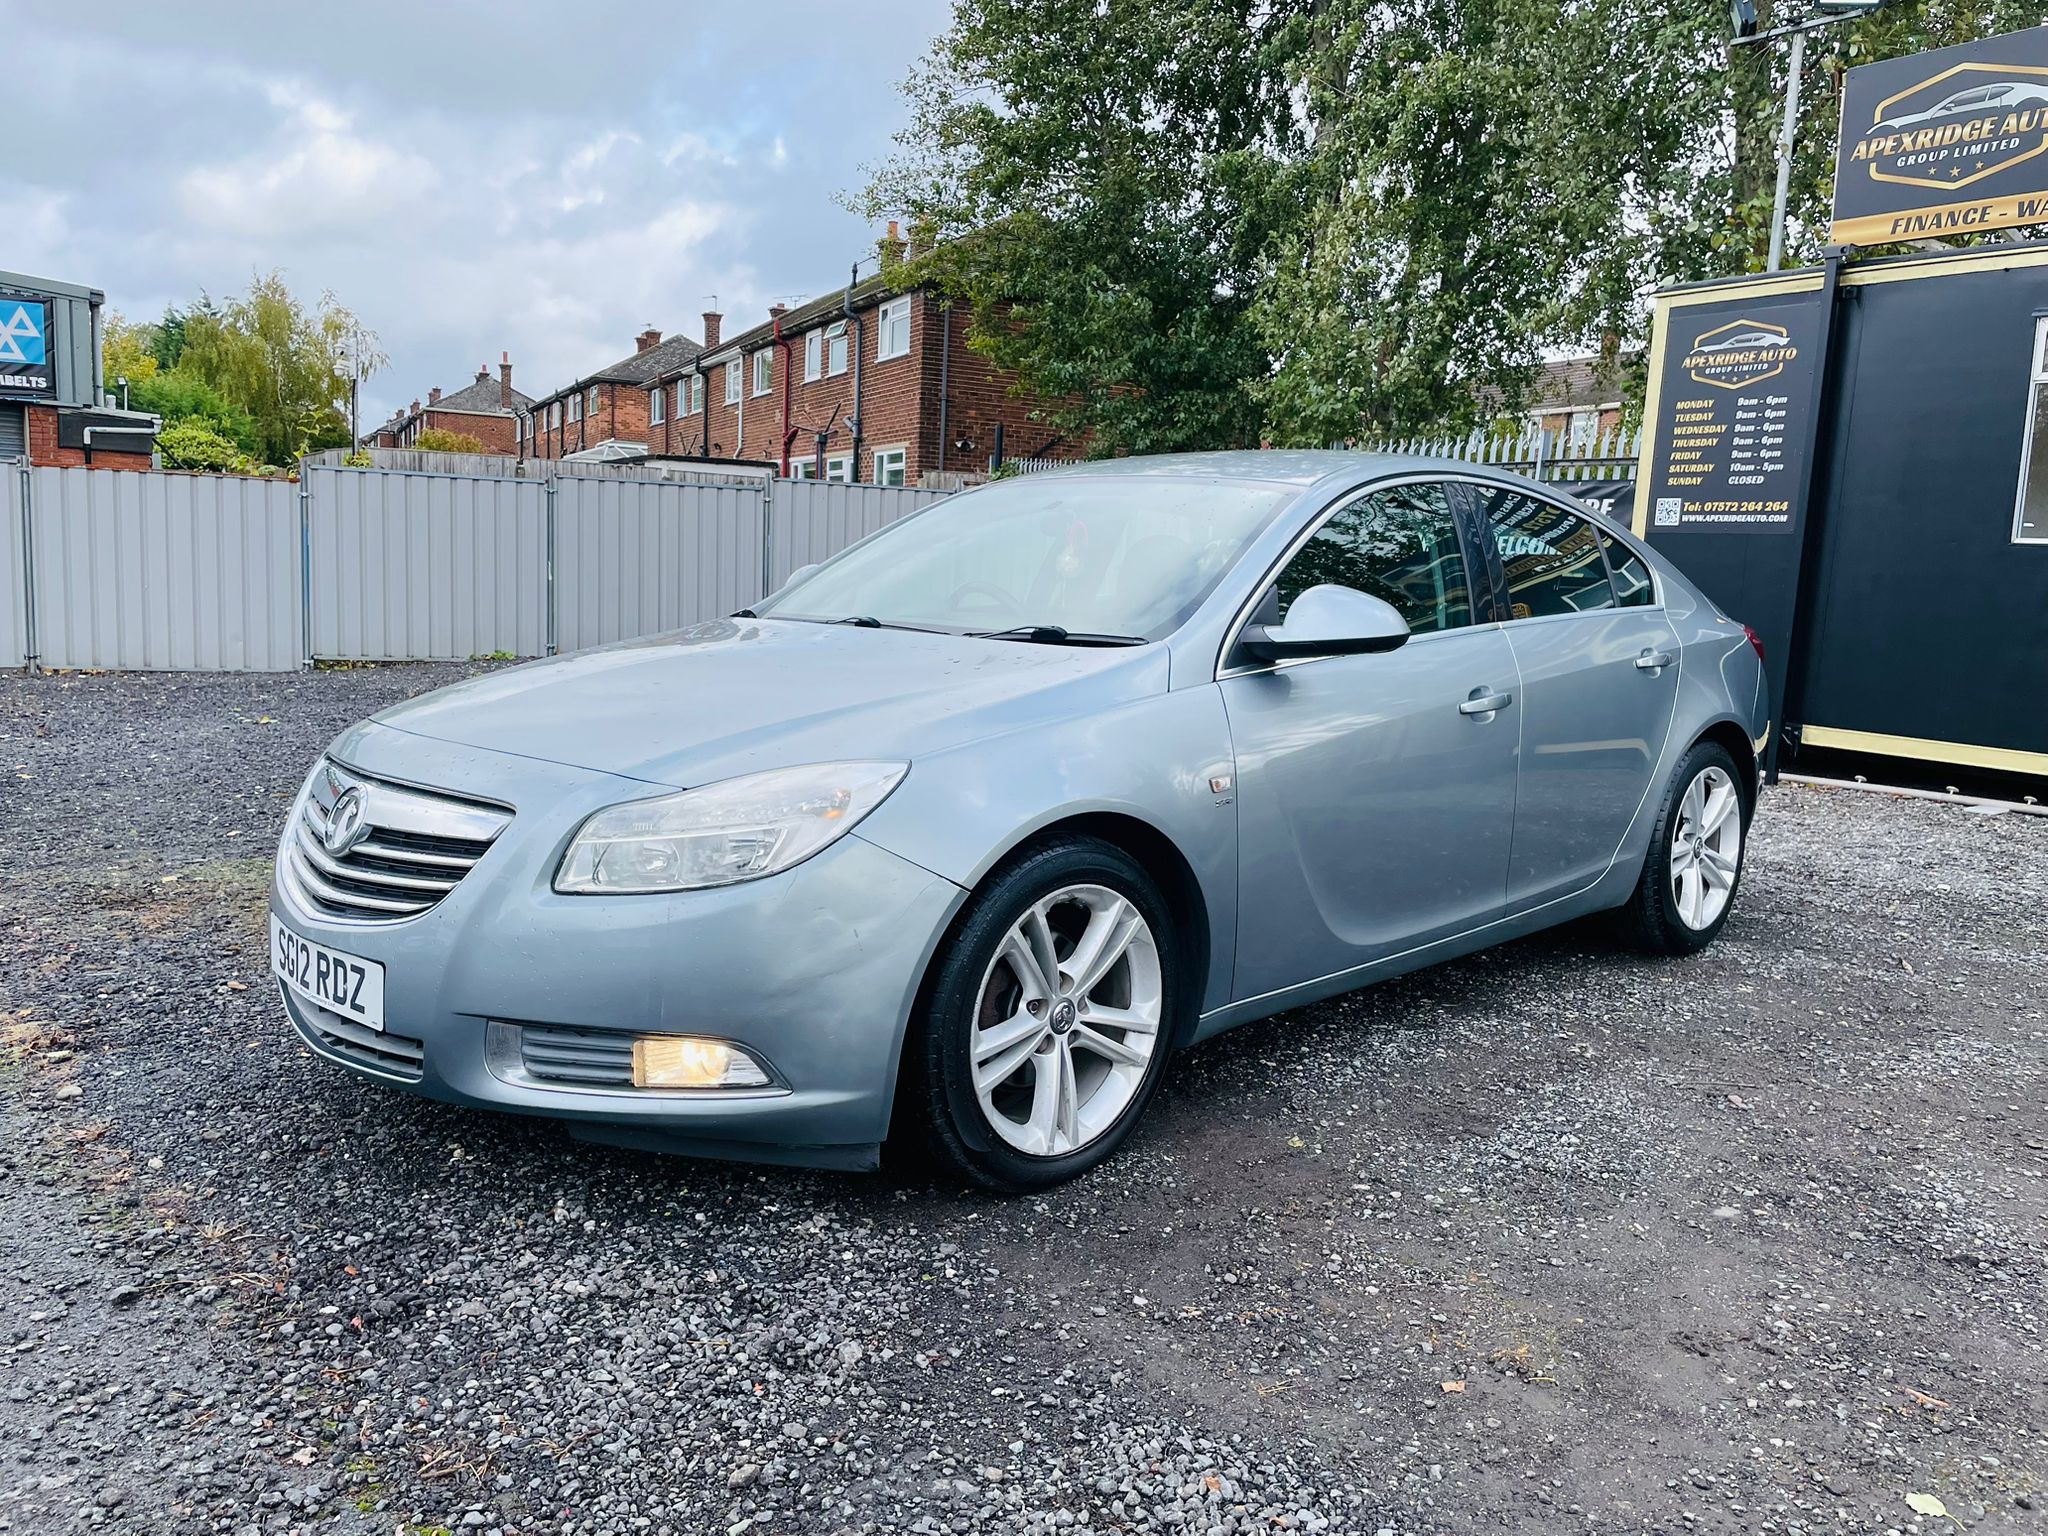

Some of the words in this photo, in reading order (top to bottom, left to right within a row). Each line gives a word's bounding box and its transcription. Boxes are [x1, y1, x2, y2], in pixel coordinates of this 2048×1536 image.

[1850, 117, 1998, 162] APEXRIDGE
[1896, 149, 1948, 167] GROUP
[1953, 137, 2020, 158] LIMITED
[1890, 205, 1993, 235] FINANCE
[1681, 351, 1758, 369] APEXRIDGE
[1757, 347, 1798, 362] AUTO
[1705, 366, 1733, 375] GROUP
[1734, 363, 1769, 372] LIMITED
[1676, 399, 1715, 410] MONDAY
[1737, 397, 1758, 406] 9am
[1766, 395, 1788, 405] 6pm
[1675, 412, 1714, 422] TUESDAY
[1735, 410, 1756, 419] 9am
[1764, 409, 1786, 419] 6pm
[1673, 424, 1728, 435] WEDNESDAY
[1734, 424, 1755, 432] 9am
[1762, 422, 1784, 432] 6pm
[1672, 438, 1719, 448] THURSDAY
[1732, 437, 1753, 445] 9am
[1761, 435, 1783, 445] 6pm
[1670, 451, 1702, 460] FRIDAY
[1731, 450, 1752, 458] 9am
[1760, 449, 1781, 459] 6pm
[1668, 463, 1715, 473] SATURDAY
[1730, 463, 1754, 471] 10am
[1762, 462, 1784, 472] 5pm
[1667, 476, 1703, 486] SUNDAY
[1728, 475, 1764, 485] CLOSED
[1683, 502, 1701, 512] Tel:
[1704, 501, 1738, 512] 07572
[1740, 501, 1763, 512] 264
[1764, 501, 1788, 512] 264
[1681, 514, 1788, 523] WWW.APEXRIDGEAUTO.COM
[278, 927, 310, 990] SG12
[317, 950, 366, 1015] RDZ
